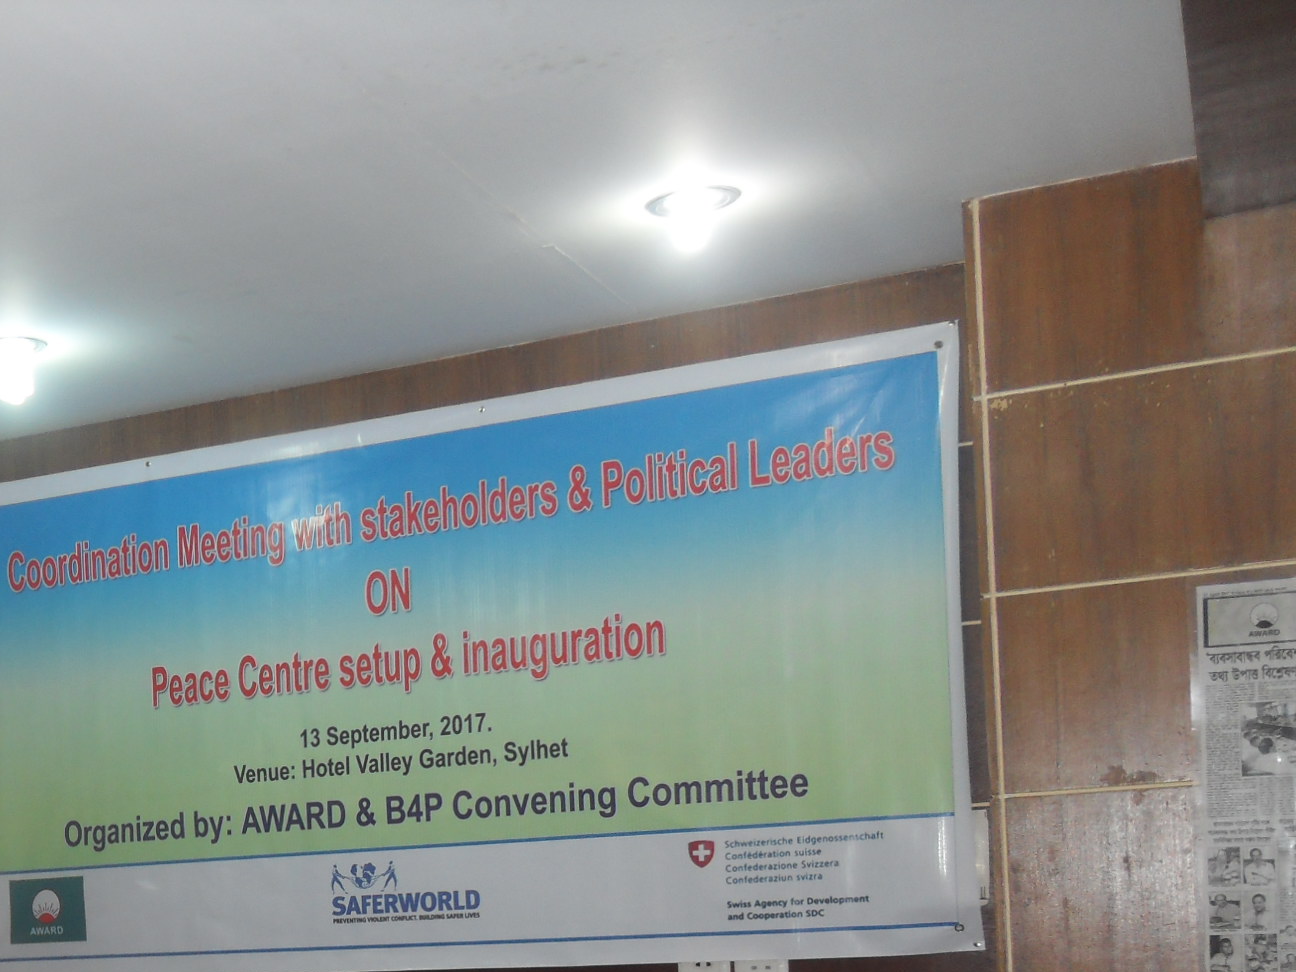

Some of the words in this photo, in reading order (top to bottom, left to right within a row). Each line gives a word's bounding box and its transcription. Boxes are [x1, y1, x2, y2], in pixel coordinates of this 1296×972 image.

[8, 532, 170, 593] Coordination
[177, 516, 286, 566] Meeting
[291, 501, 352, 551] with
[359, 477, 558, 543] stakeholders
[567, 464, 593, 512] &
[601, 442, 739, 508] Political
[748, 427, 896, 488] Leaders
[364, 566, 412, 616] ON
[1248, 629, 1281, 637] AWARD
[151, 664, 230, 708] Peace
[238, 652, 330, 698] Centre
[339, 642, 422, 692] setup
[430, 633, 453, 678] &
[463, 614, 667, 680] inauguration
[300, 727, 321, 748] 13
[326, 719, 434, 748] September,
[440, 713, 493, 738] 2017.
[234, 762, 296, 784] Venue:
[302, 756, 351, 778] Hotel
[356, 752, 413, 776] Valley
[419, 746, 498, 770] Garden,
[504, 738, 569, 766] Sylhet
[64, 811, 186, 852] Organized
[194, 810, 233, 844] by:
[242, 800, 347, 834] AWARD
[356, 798, 377, 827] &
[386, 792, 443, 825] B4P
[453, 783, 617, 820] Convening
[628, 770, 809, 808] Committee
[725, 837, 793, 848] Schweizerische
[797, 831, 884, 845] Eidgenossenschaft
[725, 849, 791, 860] Confédération
[795, 848, 822, 857] suisse
[725, 861, 798, 873] Confederazione
[801, 859, 840, 869] Svizzera
[725, 873, 793, 885] Confederaziun
[796, 872, 823, 881] svizra
[332, 889, 481, 916] SAFERWORLD
[727, 900, 751, 909] Swiss
[754, 898, 788, 910] Agency
[791, 897, 804, 906] for
[806, 895, 870, 906] Development
[728, 912, 744, 921] and
[747, 910, 803, 922] Cooperation
[806, 909, 825, 918] SDC
[30, 925, 64, 936] AWARD
